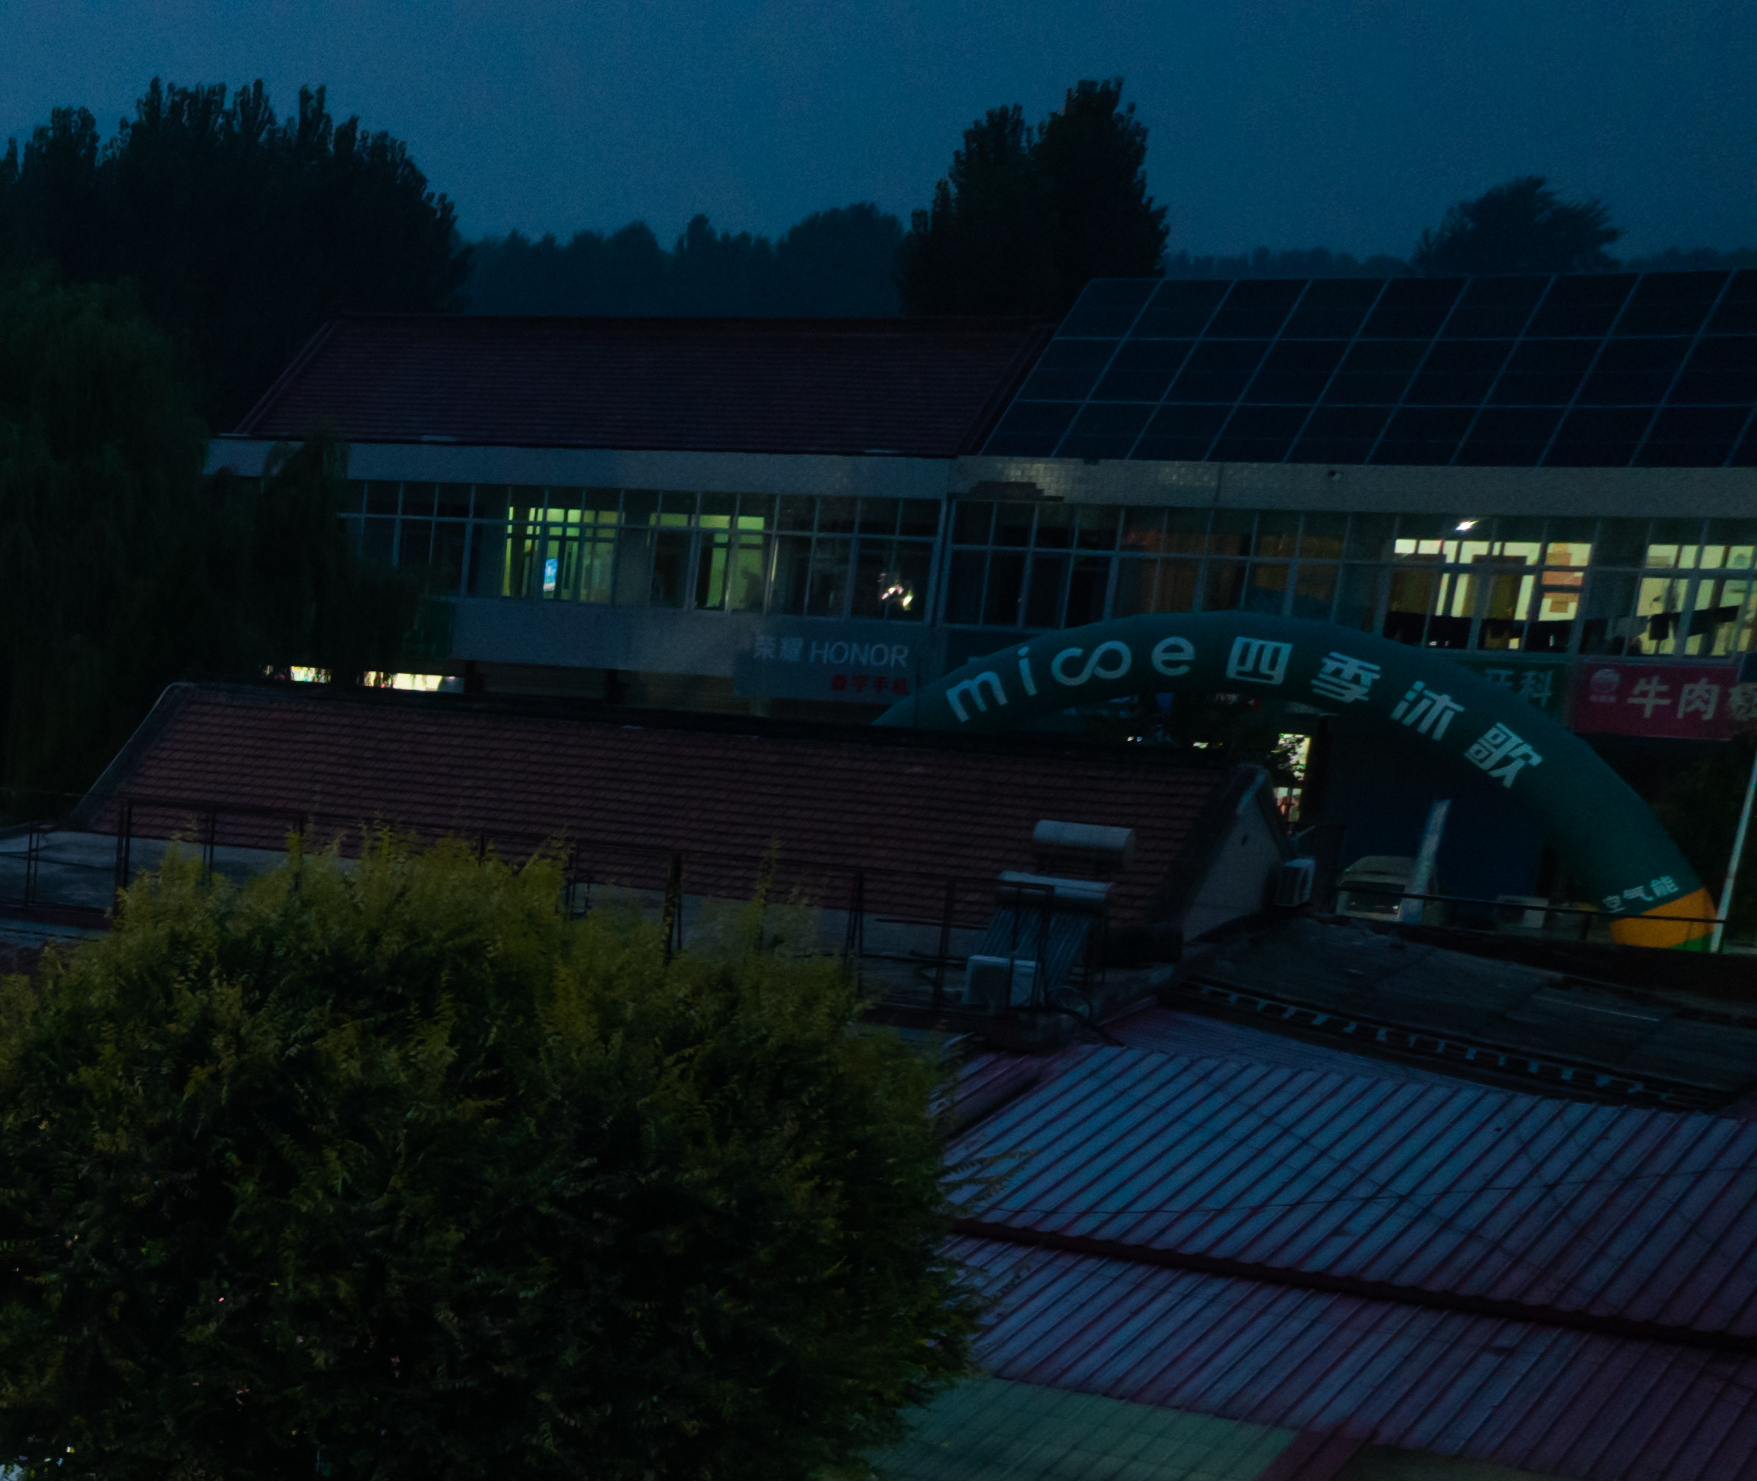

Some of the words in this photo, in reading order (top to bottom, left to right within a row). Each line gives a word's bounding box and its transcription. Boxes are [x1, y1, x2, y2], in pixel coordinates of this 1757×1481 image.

[809, 640, 909, 668] HONOR
[1226, 636, 1543, 790] 四季沐歌
